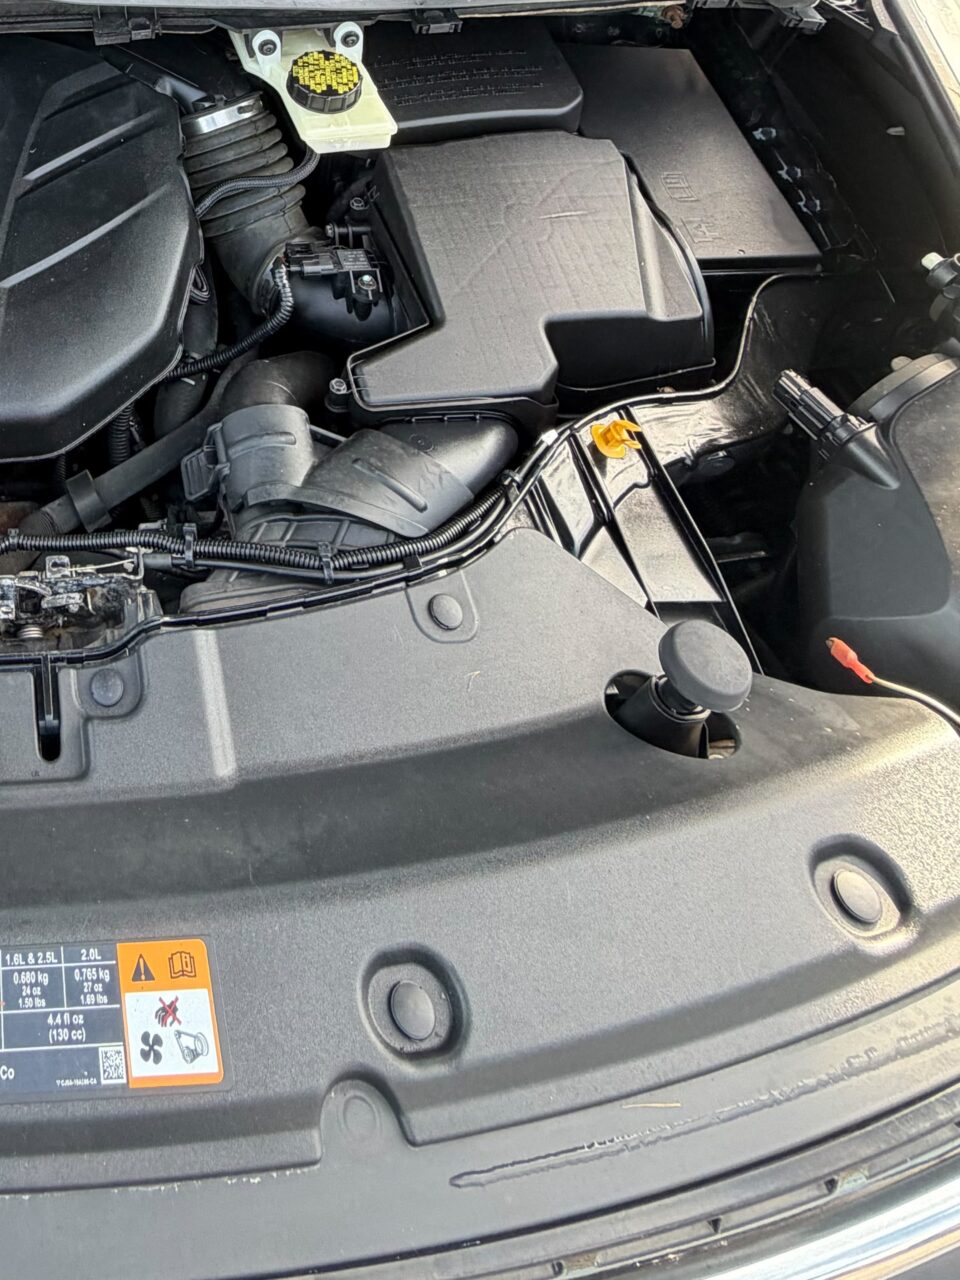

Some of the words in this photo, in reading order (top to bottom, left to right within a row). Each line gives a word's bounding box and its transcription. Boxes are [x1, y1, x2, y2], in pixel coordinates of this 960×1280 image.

[5, 953, 25, 966] 1.6L
[27, 952, 35, 965] &
[37, 951, 58, 964] 2.5L
[80, 948, 102, 961] 2.0L
[13, 971, 36, 985] 0.680
[37, 970, 49, 986] kg
[74, 968, 97, 982] 0.765
[98, 967, 110, 982] kg
[22, 985, 31, 996] 24
[32, 986, 42, 996] oz
[83, 982, 92, 993] 27
[93, 983, 103, 993] oz
[18, 997, 34, 1009] 1.50
[34, 996, 46, 1008] lbs
[96, 994, 108, 1005] lbs
[47, 1012, 62, 1026] 4.4
[72, 1014, 84, 1025] oz
[48, 1028, 69, 1044] (130
[70, 1026, 86, 1043] cc)
